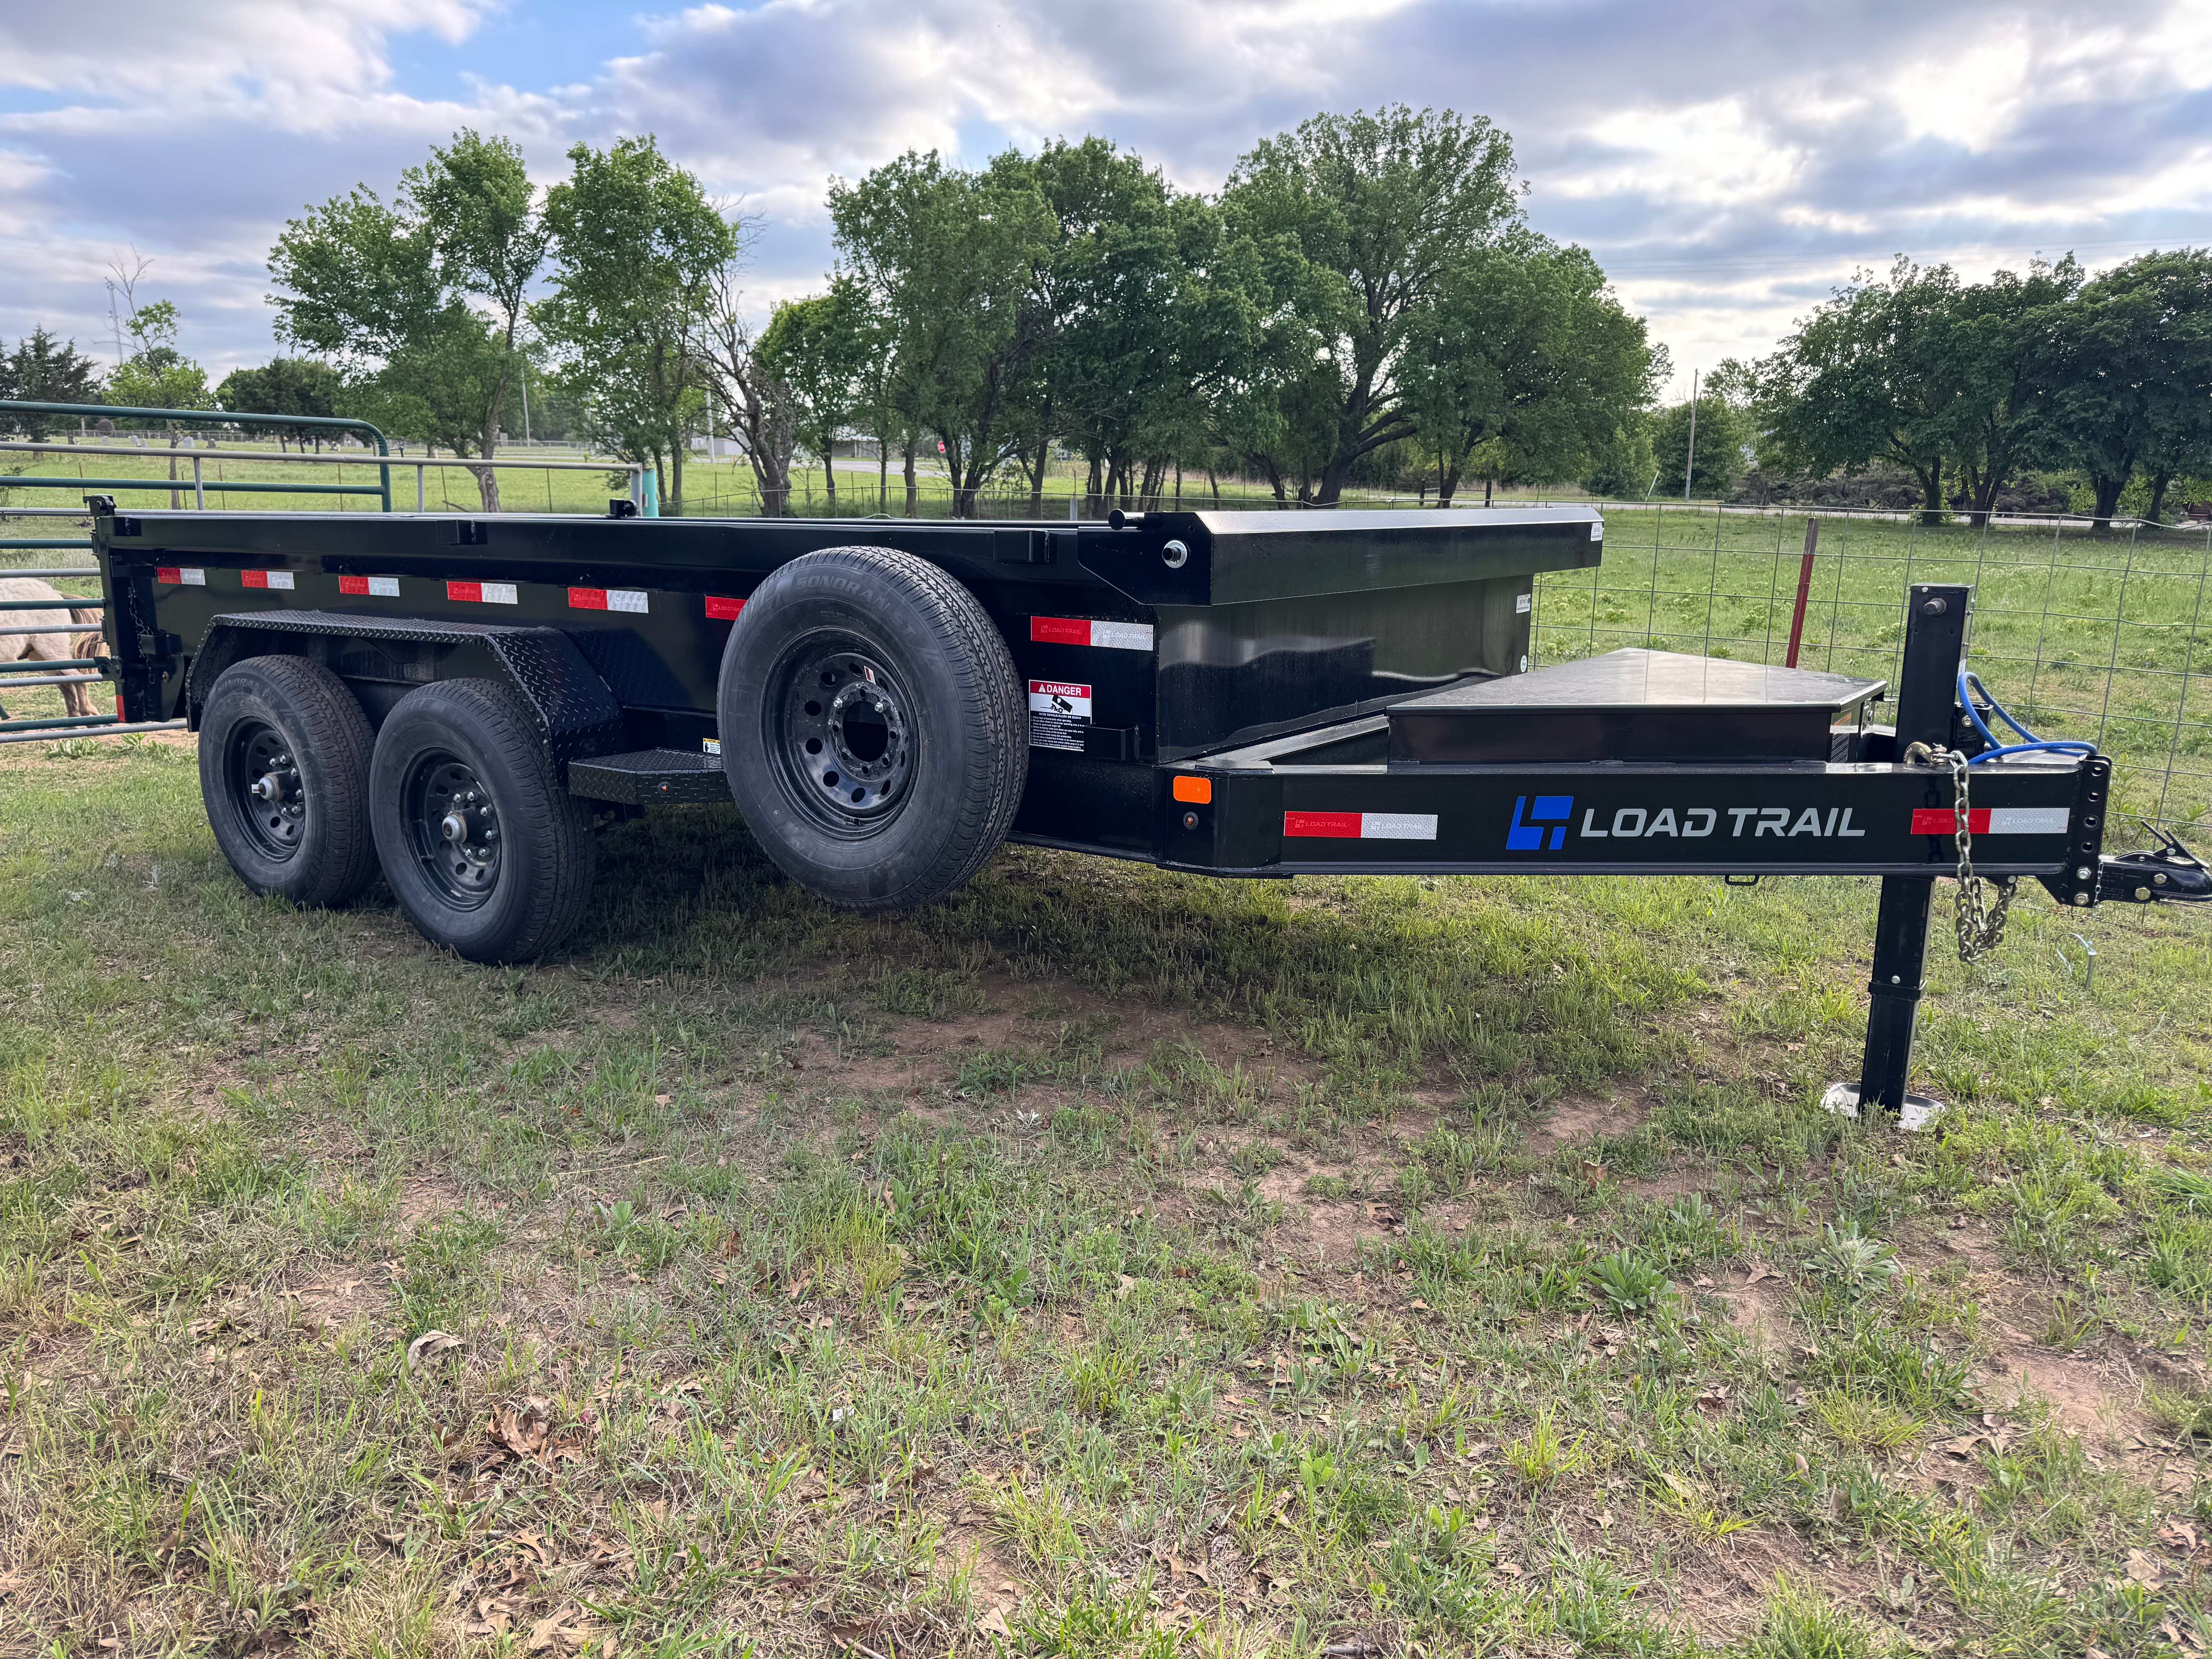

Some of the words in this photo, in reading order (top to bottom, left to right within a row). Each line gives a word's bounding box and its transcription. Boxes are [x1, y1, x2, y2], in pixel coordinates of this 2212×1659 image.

[796, 575, 891, 613] SONORAN
[892, 610, 917, 637] ST
[1047, 685, 1081, 696] DANGER
[1581, 808, 1717, 837] LOAD
[1728, 808, 1865, 836] TRAIL
